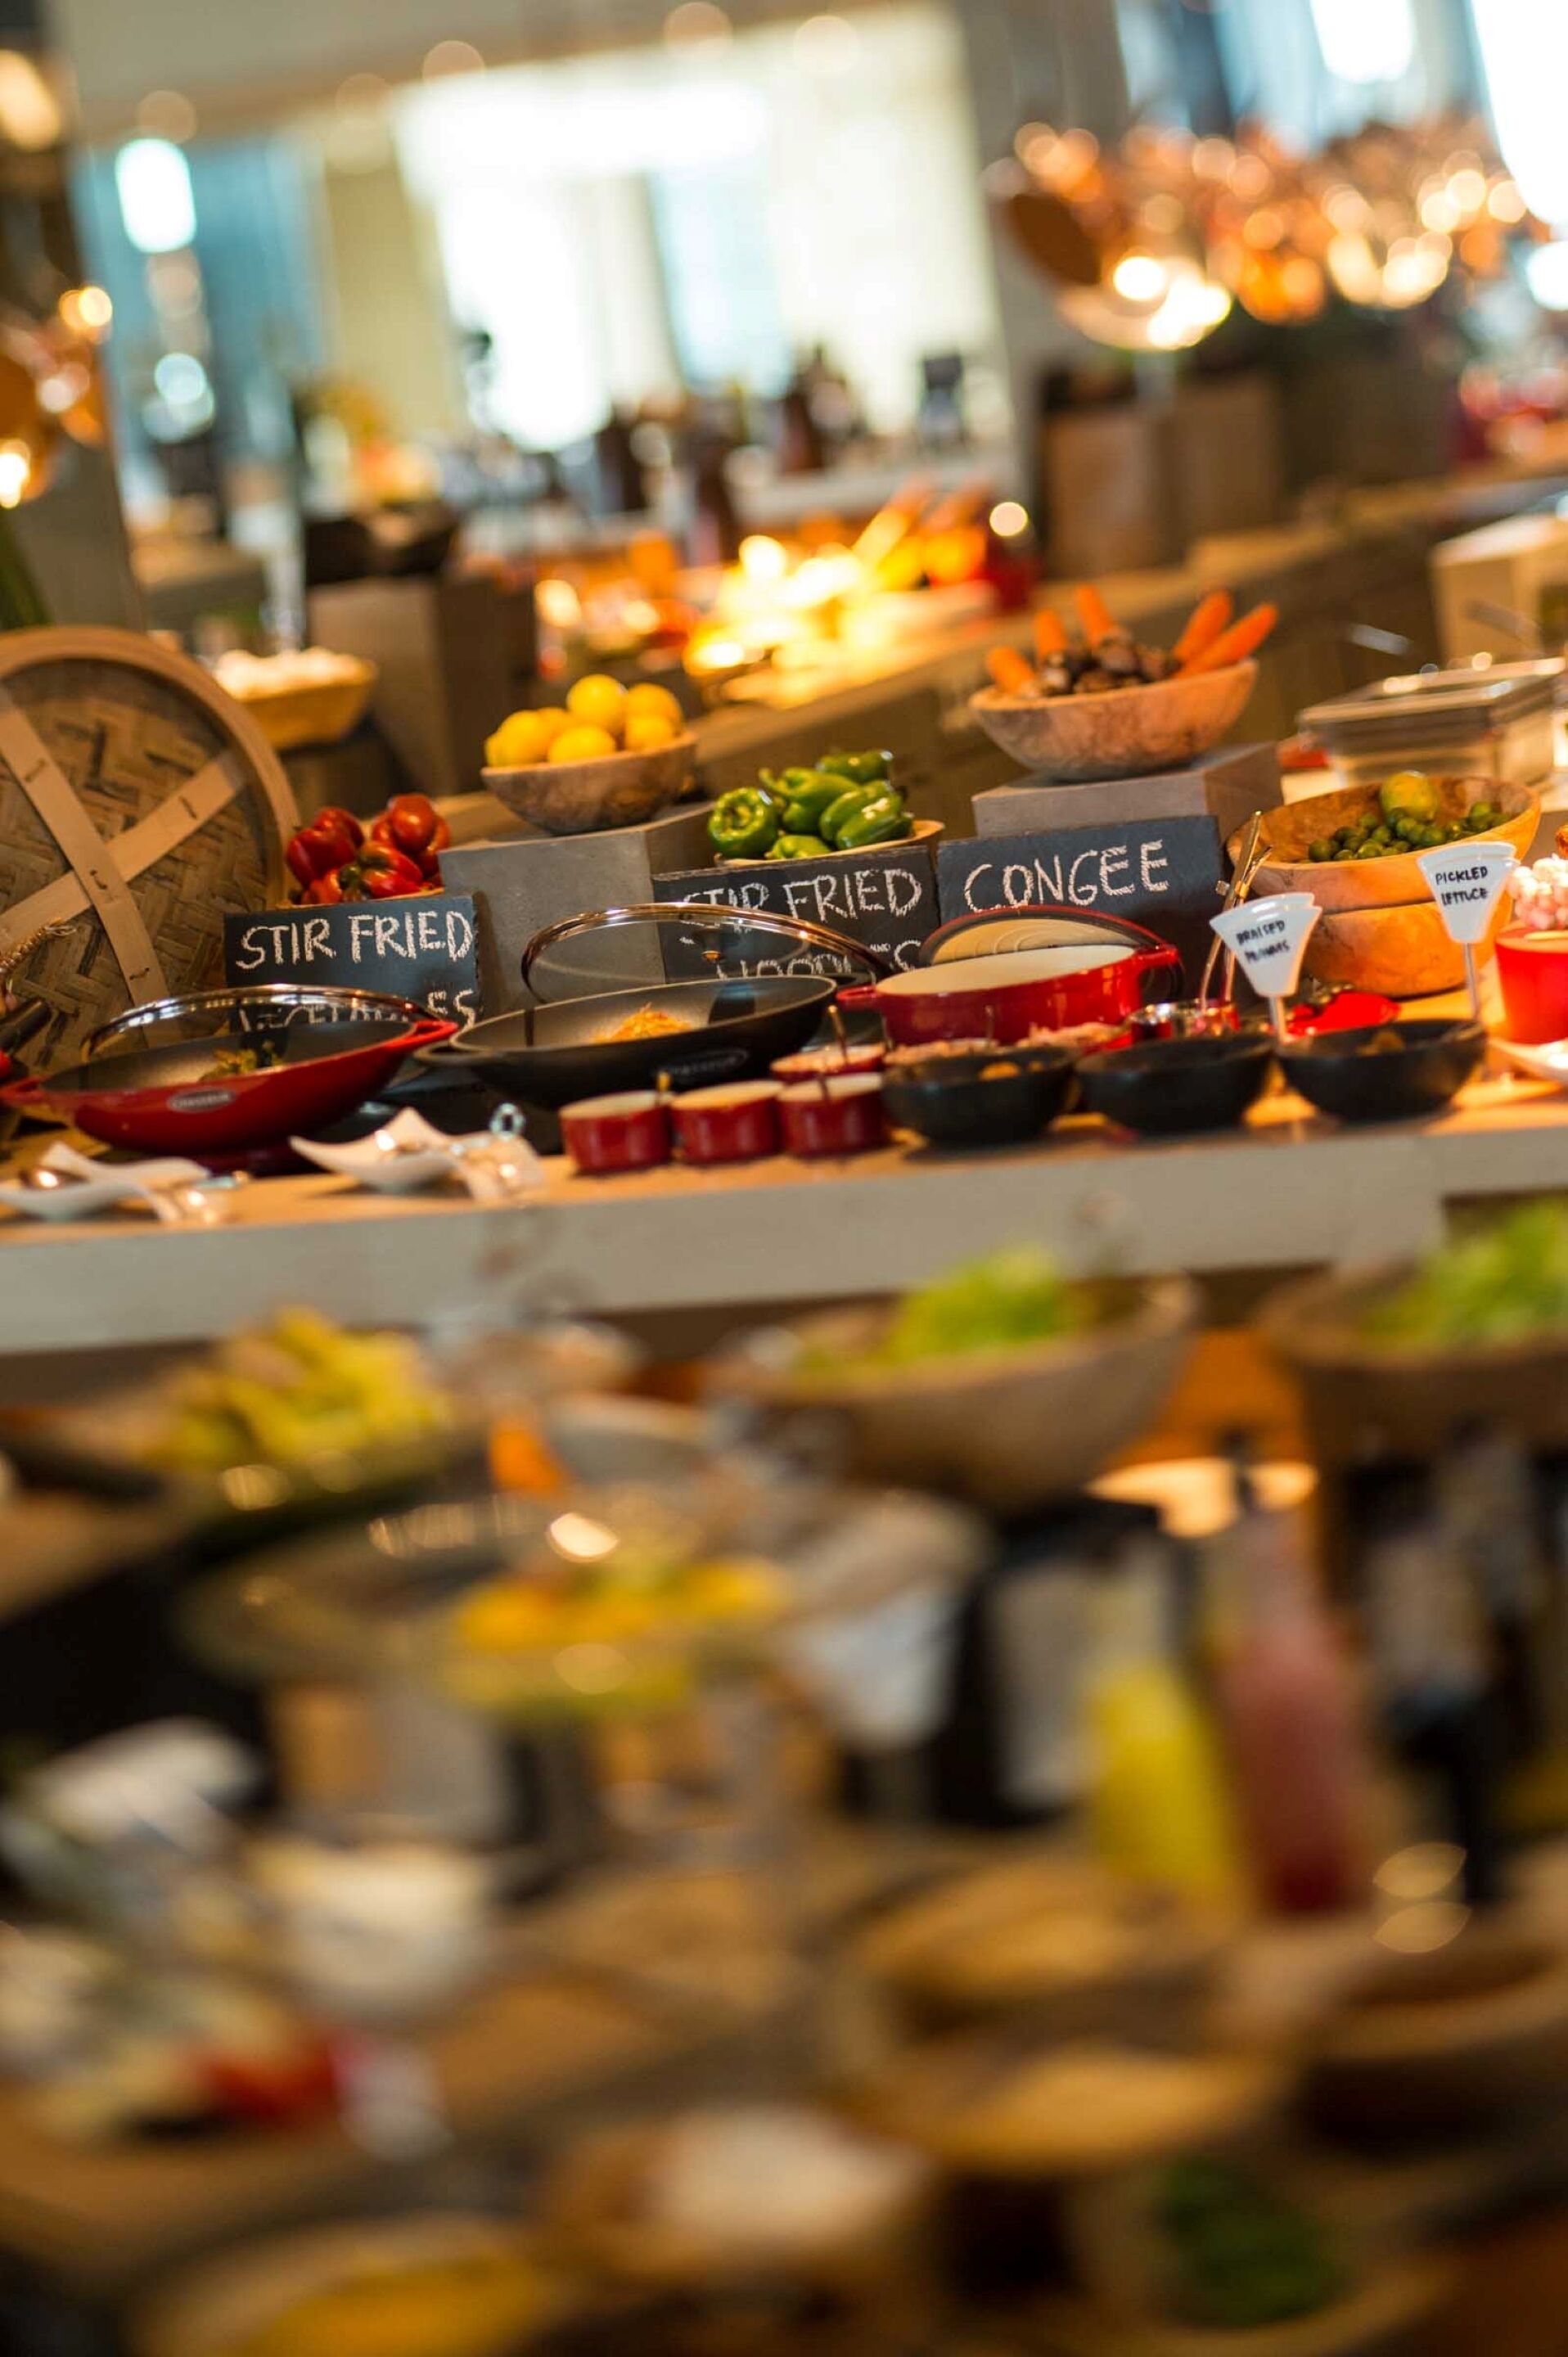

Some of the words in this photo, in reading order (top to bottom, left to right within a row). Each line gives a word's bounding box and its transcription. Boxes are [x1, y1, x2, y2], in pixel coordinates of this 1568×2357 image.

[782, 868, 923, 922] FRIED
[964, 839, 1169, 913] CONGEE
[1435, 866, 1488, 885] PICKLED
[1440, 887, 1488, 906] LETTUCE
[236, 918, 337, 970] STIR
[348, 911, 474, 963] FRIED
